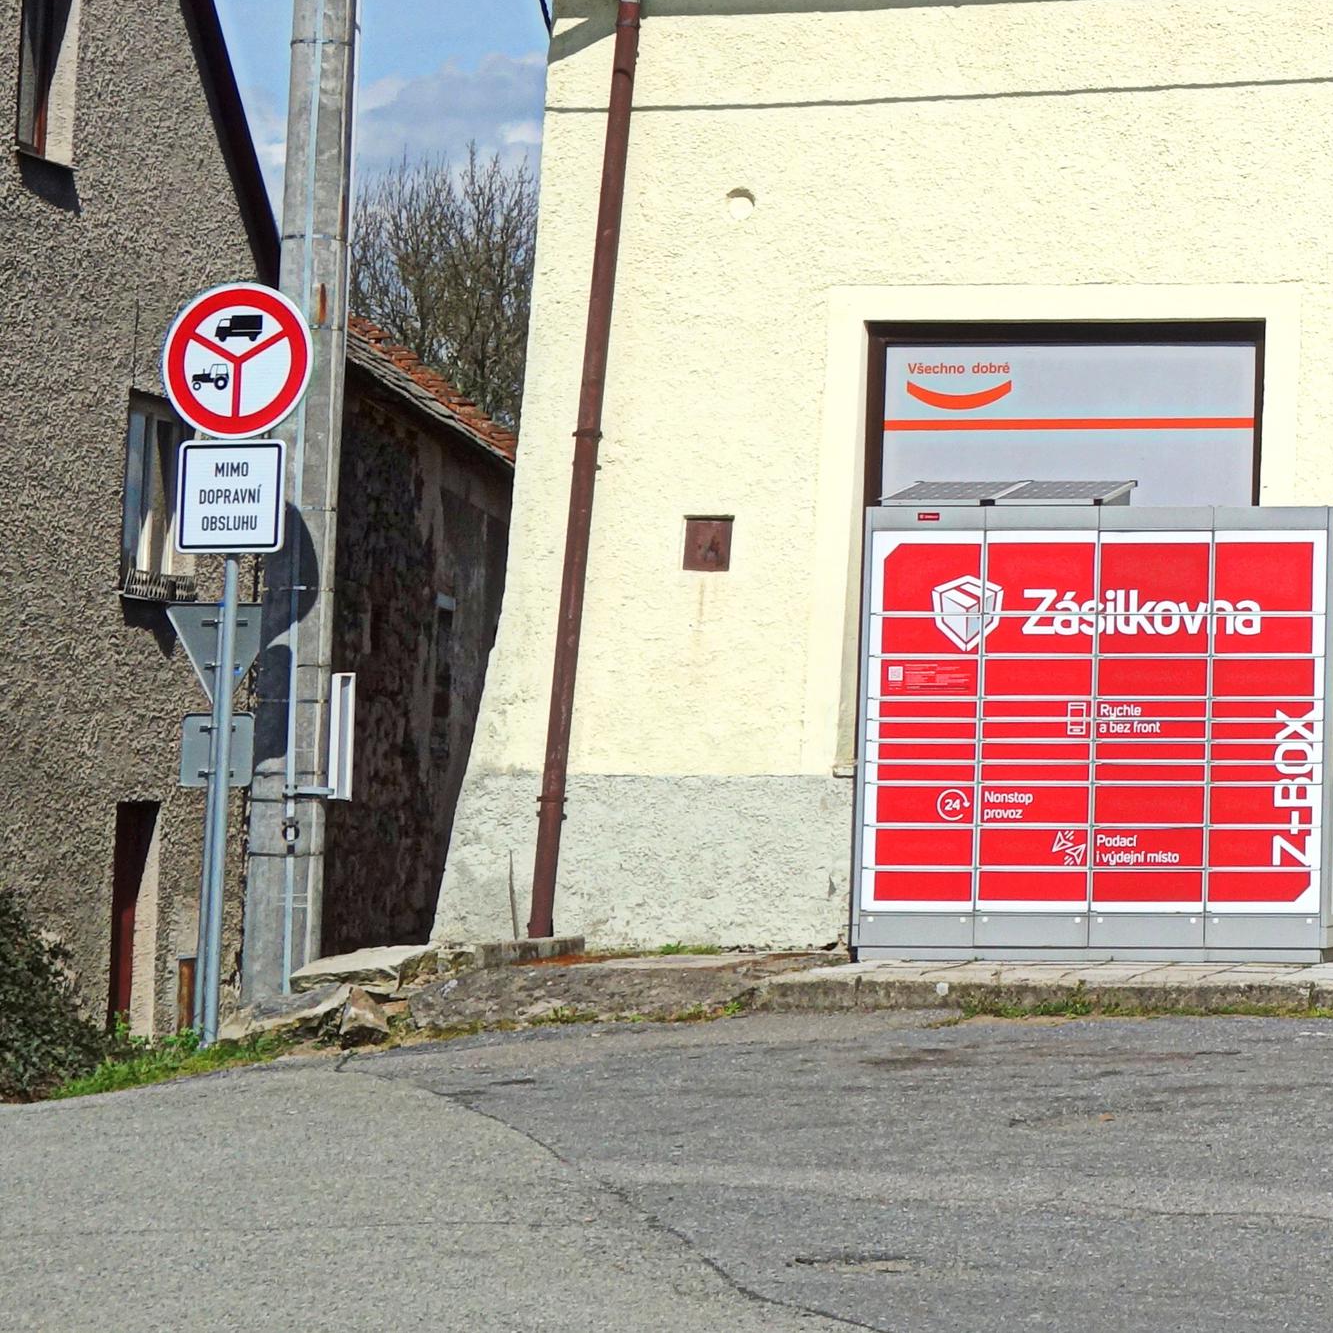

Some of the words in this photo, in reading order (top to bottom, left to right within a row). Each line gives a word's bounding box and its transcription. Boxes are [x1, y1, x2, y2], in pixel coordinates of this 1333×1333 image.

[907, 362, 965, 374] Všechno
[971, 361, 1010, 374] dobré
[214, 461, 249, 477] MIMO
[199, 483, 262, 504] DOPRAVNÍ
[201, 515, 258, 531] OBSLUHU
[1022, 589, 1262, 636] Zásilkovna
[1100, 704, 1141, 717] Rychle
[1100, 723, 1107, 733] a
[1110, 721, 1131, 733] bez
[1133, 721, 1161, 733] front
[1273, 709, 1314, 867] Z-BOX
[944, 799, 961, 811] 24
[984, 791, 1034, 805] Nonstop
[984, 808, 1024, 821] provoz
[1096, 834, 1138, 847] Podací
[1096, 851, 1100, 863] i
[1101, 850, 1145, 865] výdejní
[1147, 851, 1180, 863] místo
